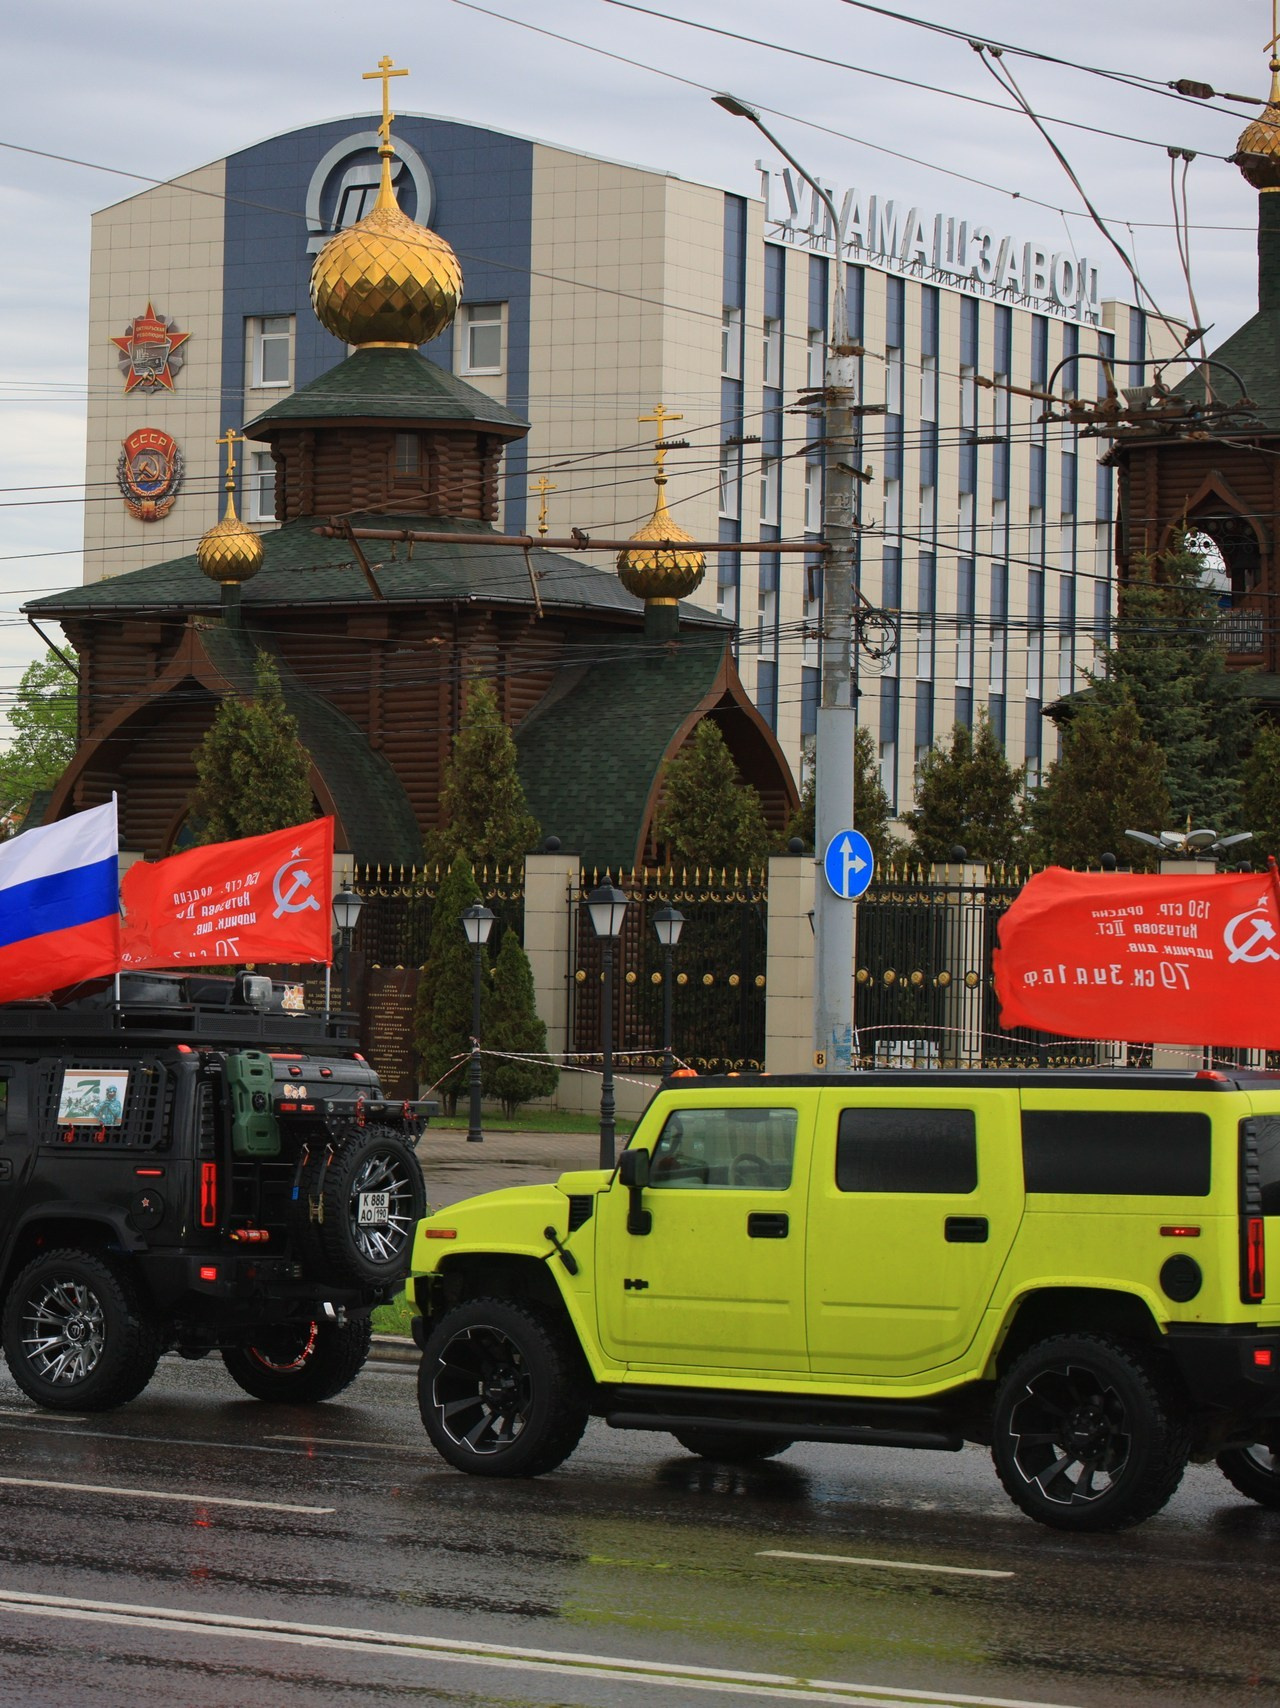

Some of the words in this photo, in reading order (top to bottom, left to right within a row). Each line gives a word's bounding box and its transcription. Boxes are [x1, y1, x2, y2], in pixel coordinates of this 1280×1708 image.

[754, 159, 1103, 327] ТУЛАМАШЗАВОД
[130, 433, 167, 449] СССР
[816, 1053, 824, 1065] 8
[363, 1194, 369, 1206] К
[371, 1194, 385, 1206] 888
[361, 1209, 373, 1222] АО
[376, 1209, 387, 1219] 190
